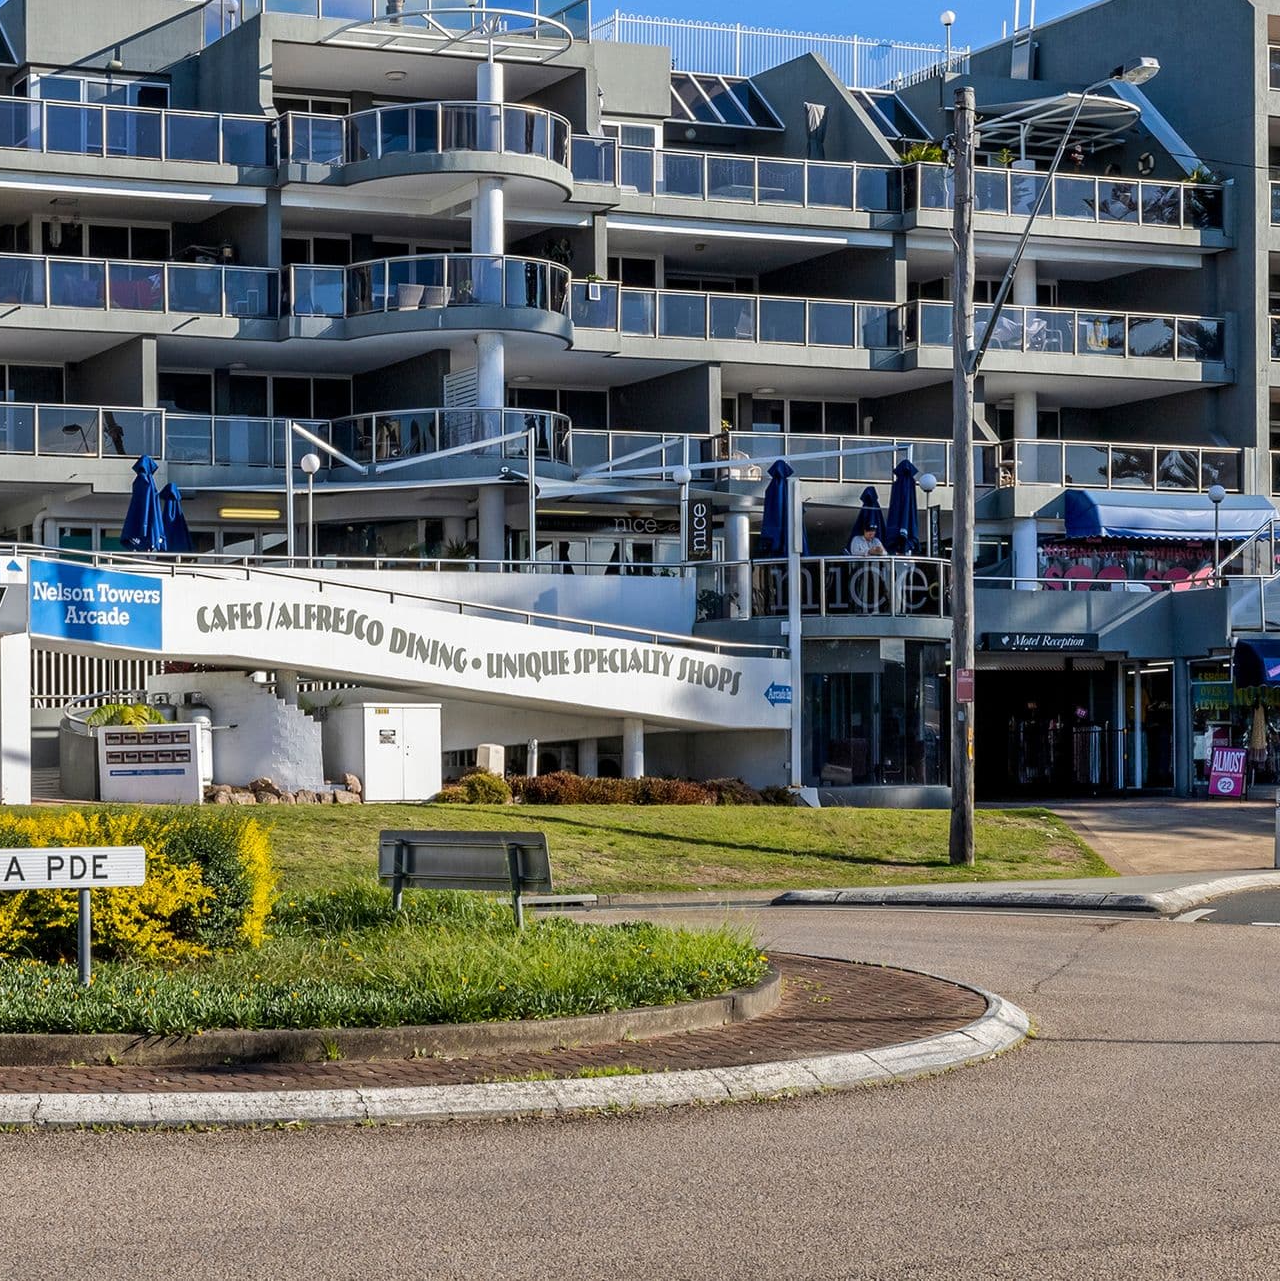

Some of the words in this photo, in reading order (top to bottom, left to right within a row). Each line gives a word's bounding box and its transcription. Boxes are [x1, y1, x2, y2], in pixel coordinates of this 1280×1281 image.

[614, 517, 658, 533] nice
[693, 502, 707, 551] nice
[33, 581, 95, 602] Nelson
[97, 584, 161, 604] Towers
[65, 606, 130, 626] Arcade
[1013, 634, 1039, 646] Motel
[1042, 635, 1085, 649] Reception
[389, 627, 468, 673] DINING
[486, 650, 570, 683] UNIQUE
[573, 647, 674, 678] SPECIALTY
[677, 656, 742, 695] SHOPS
[1212, 750, 1245, 773] ALMOST
[47, 854, 109, 880] PDE
